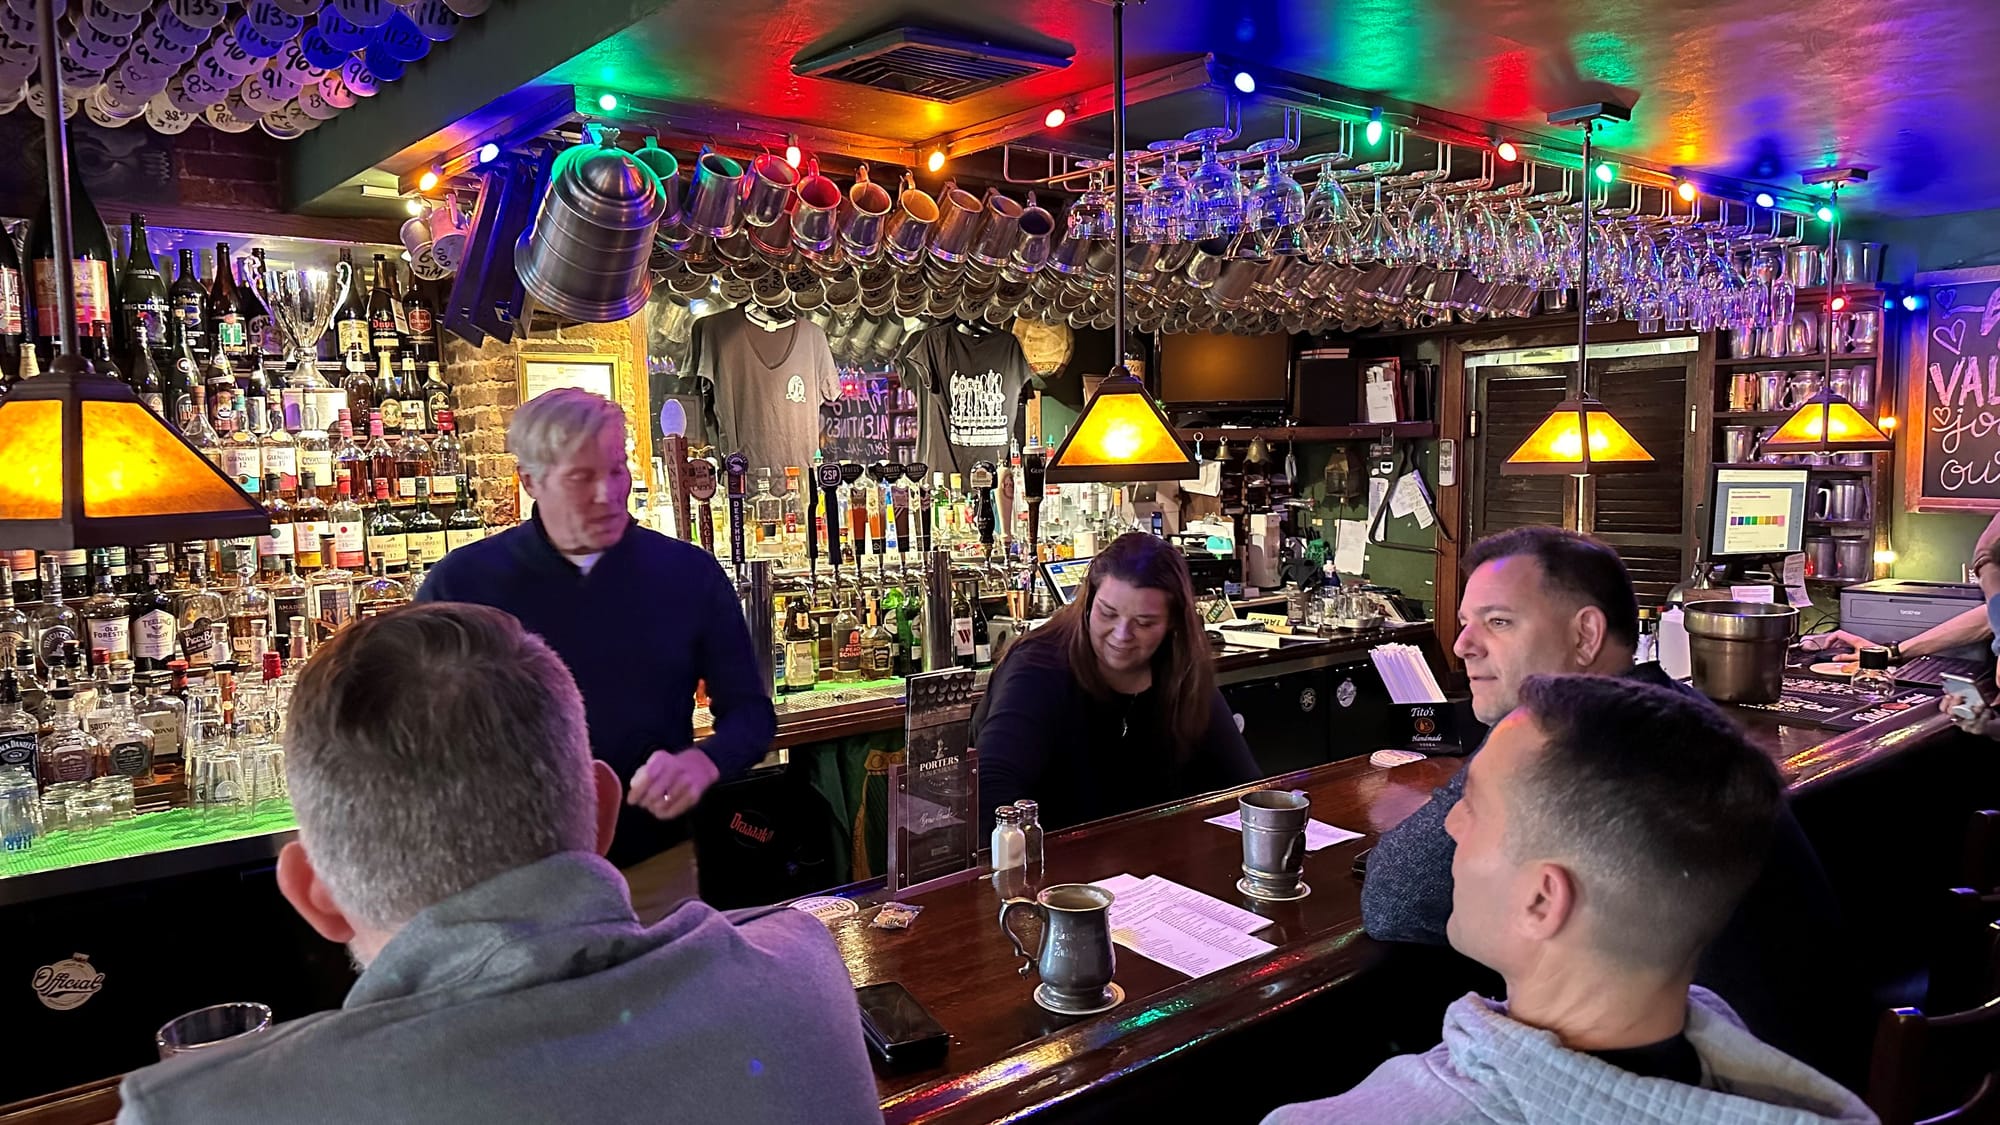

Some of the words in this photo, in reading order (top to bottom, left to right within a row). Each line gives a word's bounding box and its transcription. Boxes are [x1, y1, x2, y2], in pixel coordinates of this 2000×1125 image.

[1931, 408, 2000, 453] jo
[823, 470, 837, 480] 2SP
[733, 500, 742, 562] DESCHUTES
[1411, 706, 1434, 718] Tito's
[919, 755, 960, 771] PORTERS
[33, 966, 105, 997] Official
